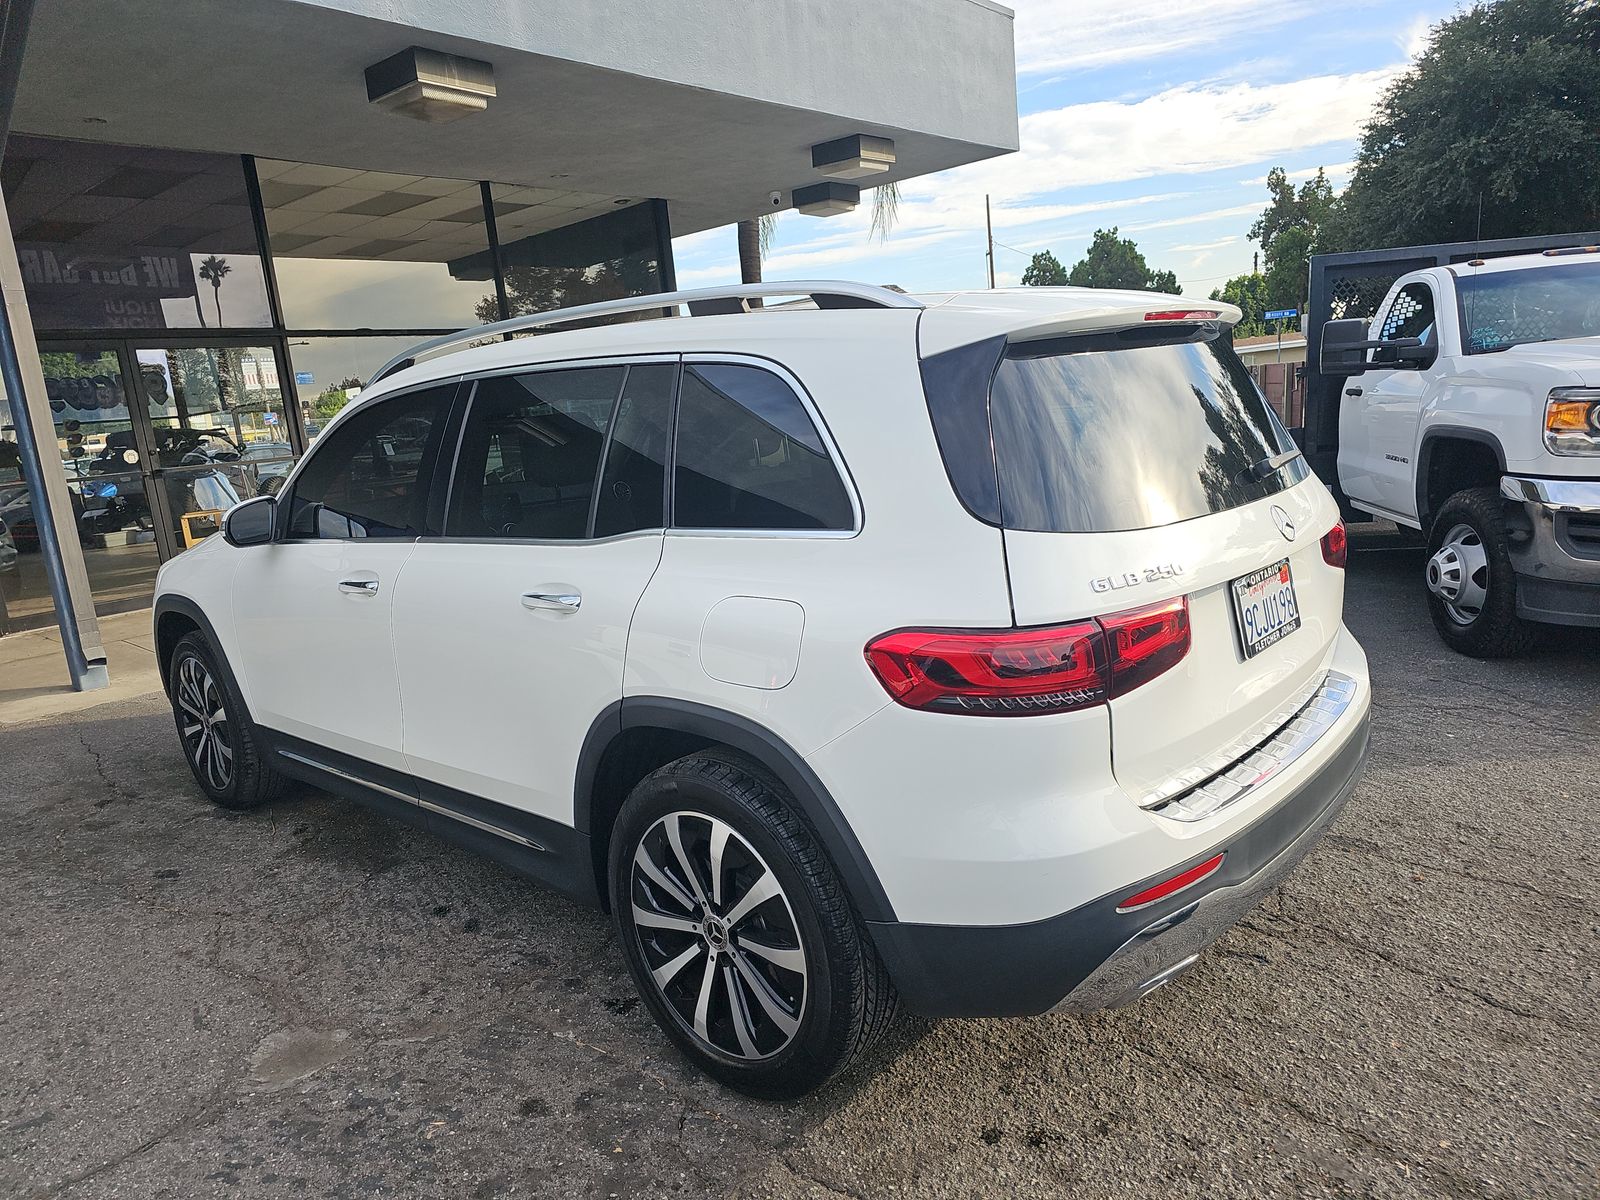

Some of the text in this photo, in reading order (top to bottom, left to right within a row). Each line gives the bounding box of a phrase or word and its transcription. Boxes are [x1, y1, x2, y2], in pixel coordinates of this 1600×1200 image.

[1088, 563, 1184, 593] GLB 250
[1250, 564, 1279, 584] ONTARIO
[1245, 587, 1295, 643] 9CJU198
[1255, 621, 1297, 652] FLETCHER JONES
